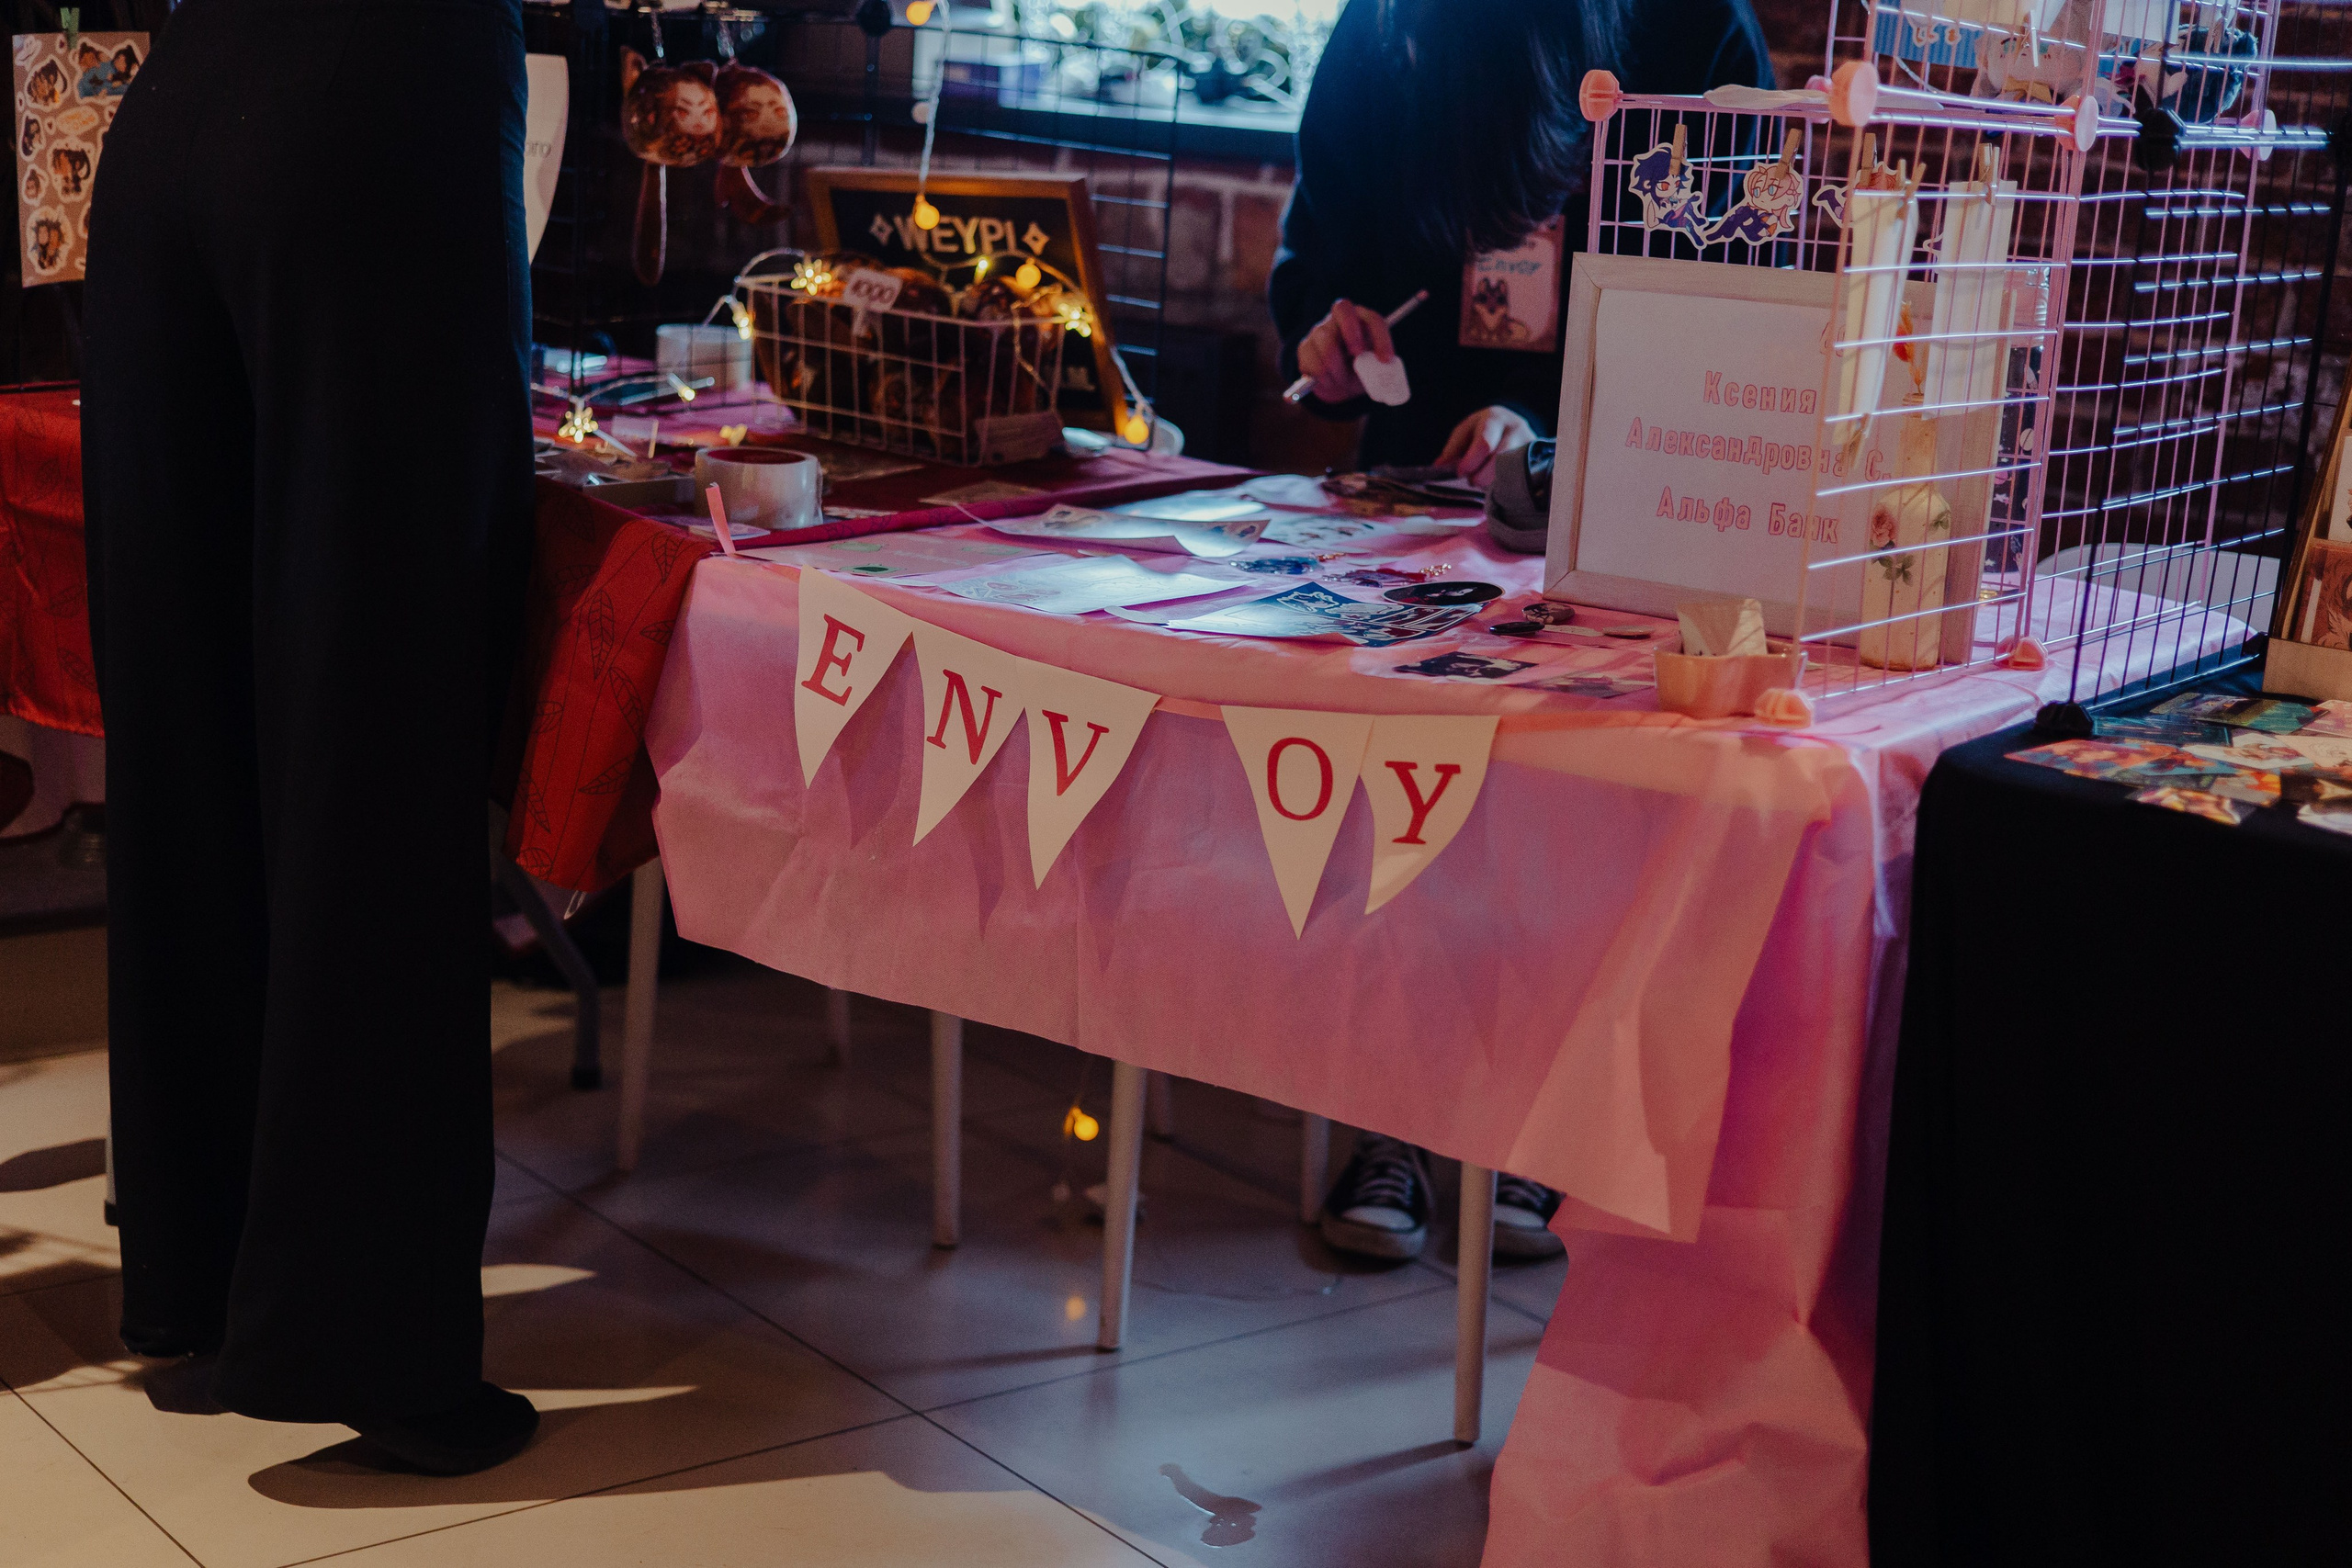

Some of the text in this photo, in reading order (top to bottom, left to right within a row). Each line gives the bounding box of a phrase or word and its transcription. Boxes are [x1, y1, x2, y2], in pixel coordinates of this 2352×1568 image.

[1703, 370, 1817, 414] Ксения
[1656, 485, 1839, 544] Альфа Банк
[797, 613, 1461, 846] ENVOY
